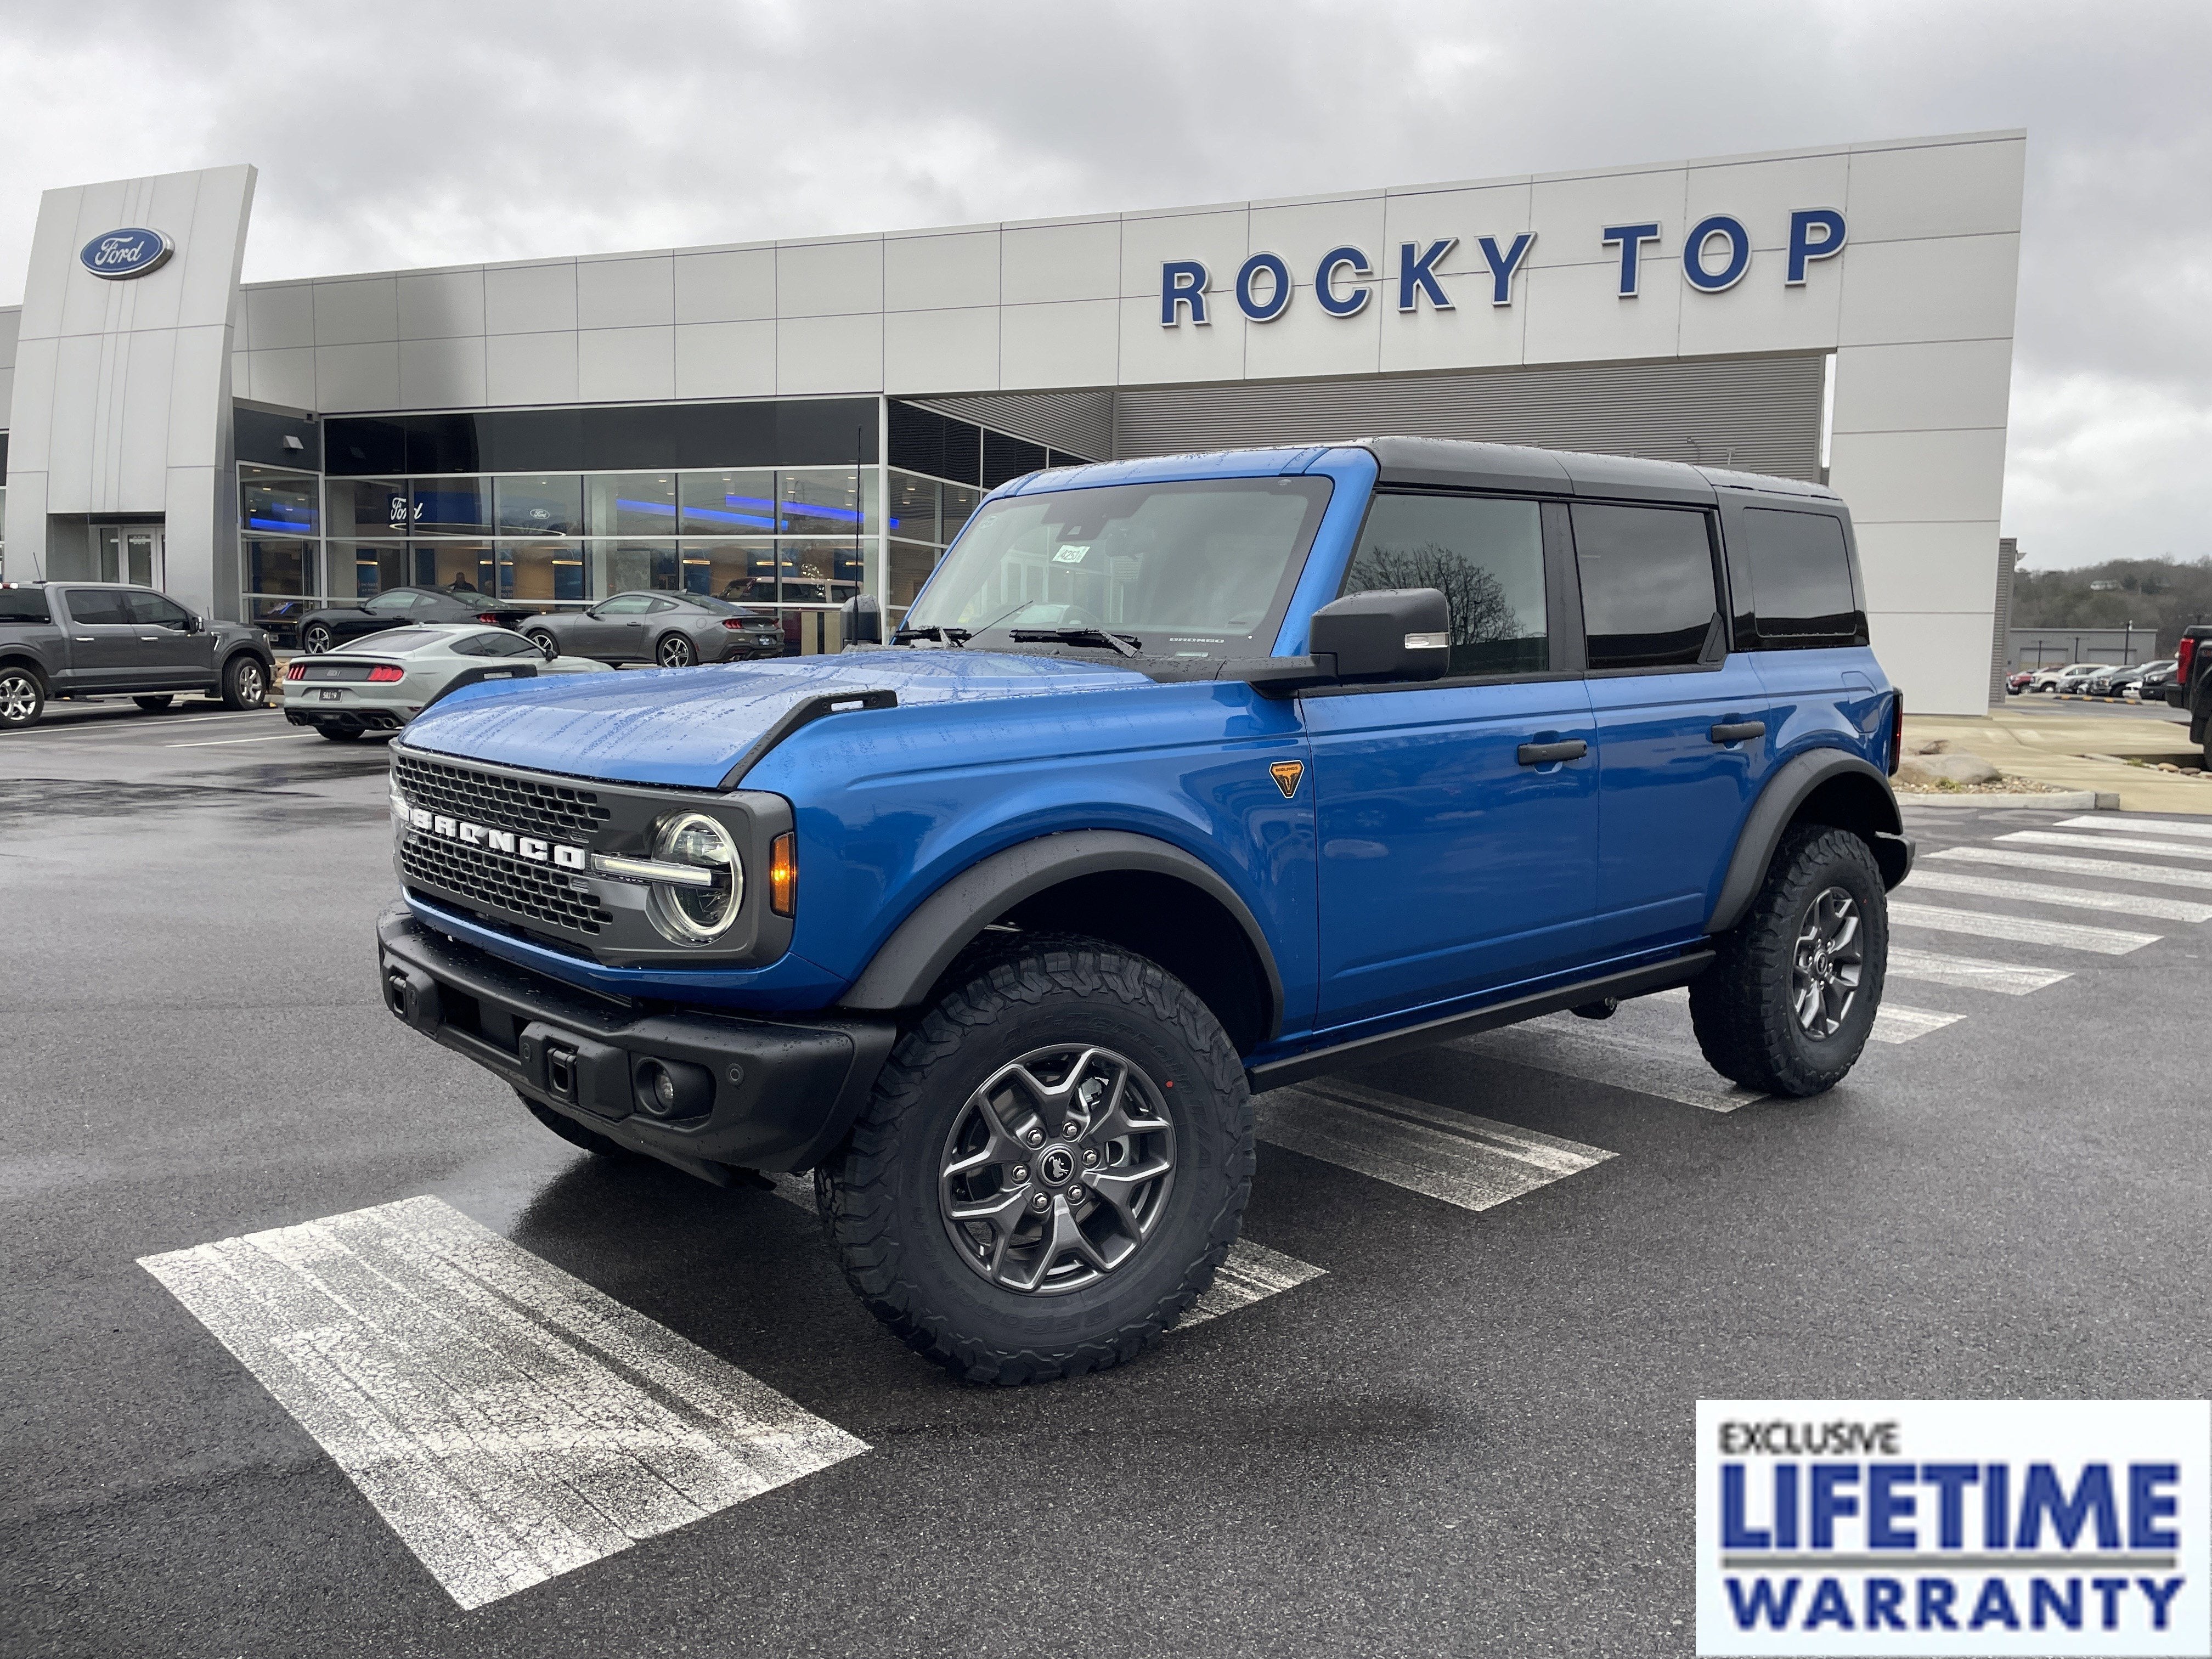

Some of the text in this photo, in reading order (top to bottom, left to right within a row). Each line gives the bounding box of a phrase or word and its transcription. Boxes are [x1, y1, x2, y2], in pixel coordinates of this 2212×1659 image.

[94, 236, 145, 266] Ford
[1160, 206, 1849, 329] ROCKY TOP
[411, 808, 586, 870] BRONCO
